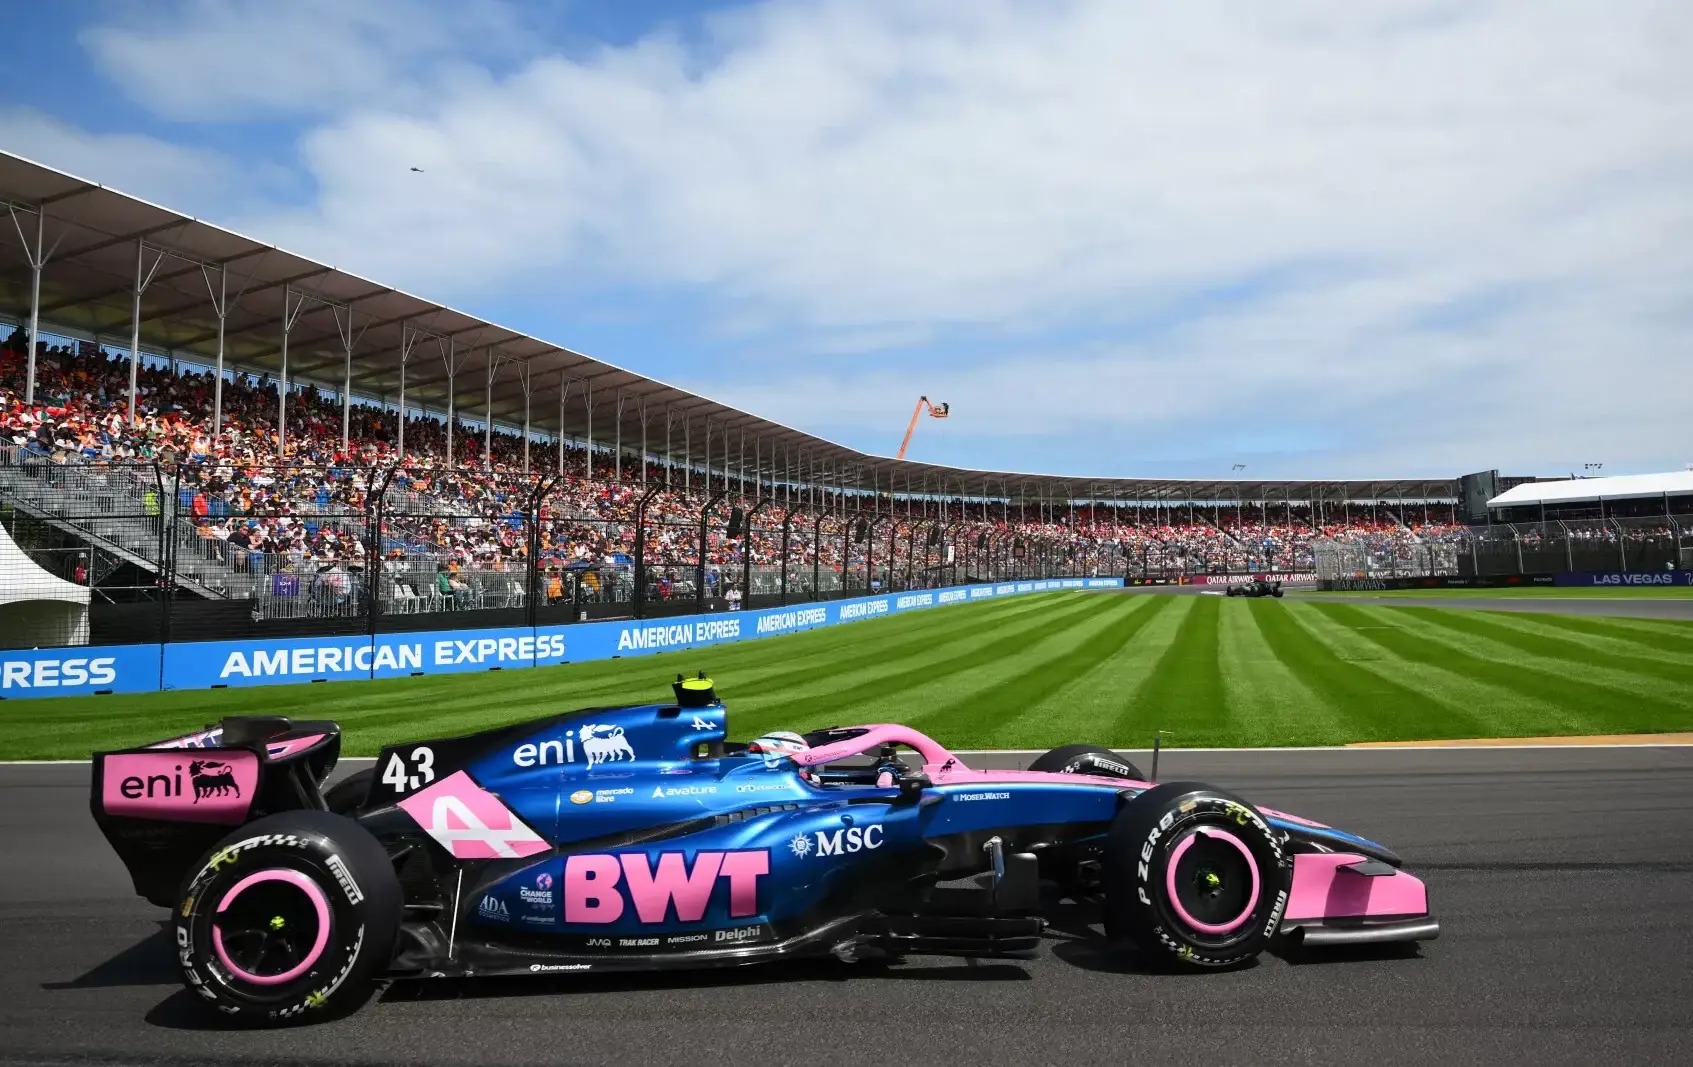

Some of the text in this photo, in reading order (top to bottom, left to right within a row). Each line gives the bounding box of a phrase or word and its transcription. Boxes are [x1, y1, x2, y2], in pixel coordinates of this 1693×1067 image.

[1207, 575, 1255, 584] QATAR AIRWAYS
[1265, 574, 1289, 582] QATAR
[1593, 574, 1673, 584] LAS VEGAS
[840, 600, 889, 619] AMERICAN EXPRESS
[896, 594, 933, 609] AMERICAN EXPRESS
[757, 607, 826, 633] AMERICAN EXPRESS
[617, 619, 741, 650] AMERICAN EXPRESS
[219, 634, 566, 679] AMERICAN EXPRESS
[0, 658, 117, 689] RESS
[513, 730, 575, 767] eni
[381, 746, 435, 793] 43
[1094, 757, 1129, 776] PIRELLI
[120, 765, 182, 799] eni
[596, 787, 634, 796] mercado
[666, 786, 717, 796] avature
[596, 795, 615, 803] libre
[815, 824, 884, 857] MSC
[1138, 811, 1174, 905] P ZERO
[324, 854, 365, 906] PIRELLI
[565, 850, 770, 924] BWT
[520, 889, 552, 898] CHANGE
[479, 894, 510, 914] ADA
[1263, 889, 1288, 939] PIRELLI
[637, 938, 659, 946] RACER
[667, 934, 708, 944] MISSION
[715, 925, 761, 942] Delphi
